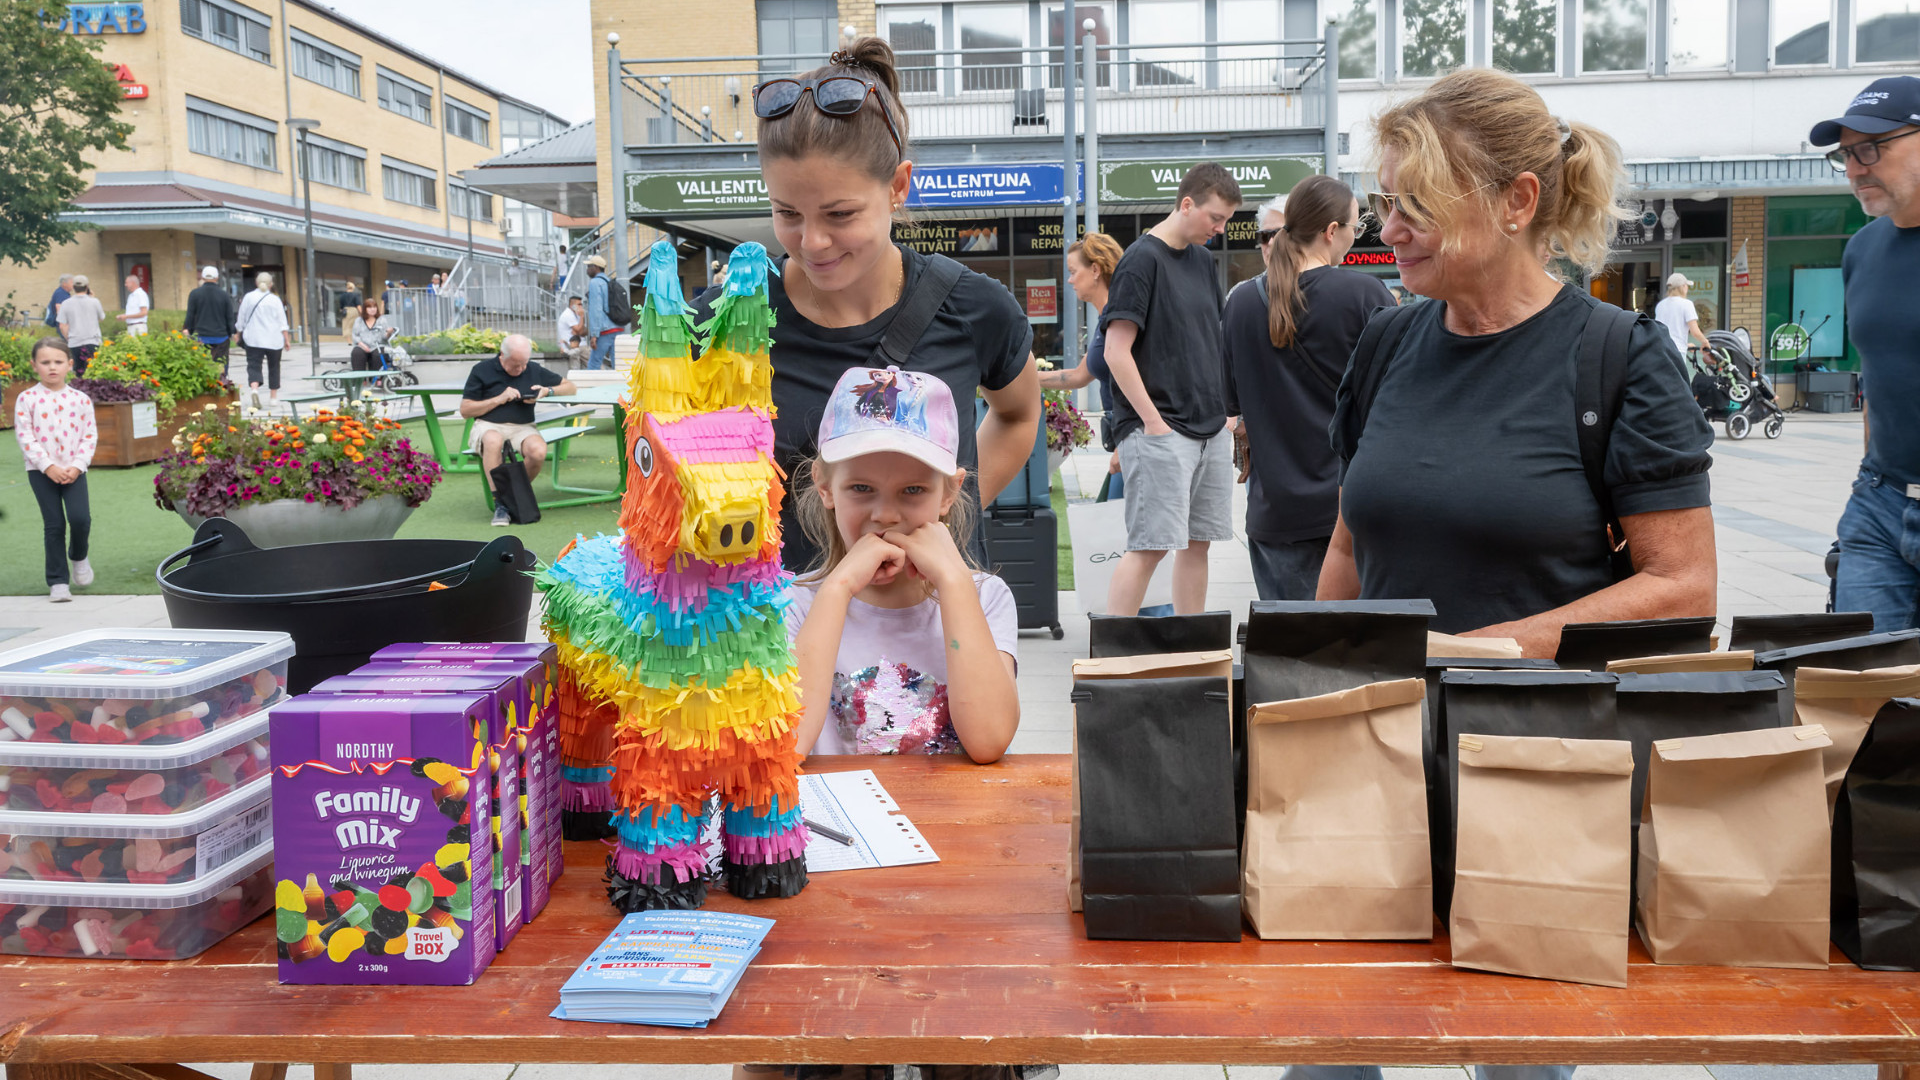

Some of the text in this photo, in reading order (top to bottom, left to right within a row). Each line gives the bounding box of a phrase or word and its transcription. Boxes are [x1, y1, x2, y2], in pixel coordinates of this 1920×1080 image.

[1151, 166, 1271, 183] VALUNA
[677, 180, 768, 195] VALLENTU
[913, 173, 1032, 190] VALLENTUNA
[714, 196, 758, 204] CENTRUM
[950, 190, 994, 198] CENTRUM
[1227, 221, 1259, 231] NYCKE
[895, 227, 957, 239] KEMTVÄTT
[1227, 231, 1256, 241] SERVI
[1031, 238, 1064, 249] REPAR
[1688, 280, 1714, 291] ULD
[1030, 288, 1051, 298] Rea
[336, 743, 394, 758] NORDTHY
[314, 786, 421, 823] Family
[335, 818, 402, 848] Mix
[339, 853, 396, 873] Liquorice
[329, 865, 412, 885] and winegum
[413, 932, 443, 941] Travel
[414, 943, 444, 955] BOX
[358, 964, 363, 972] 2
[370, 964, 388, 973] 300g
